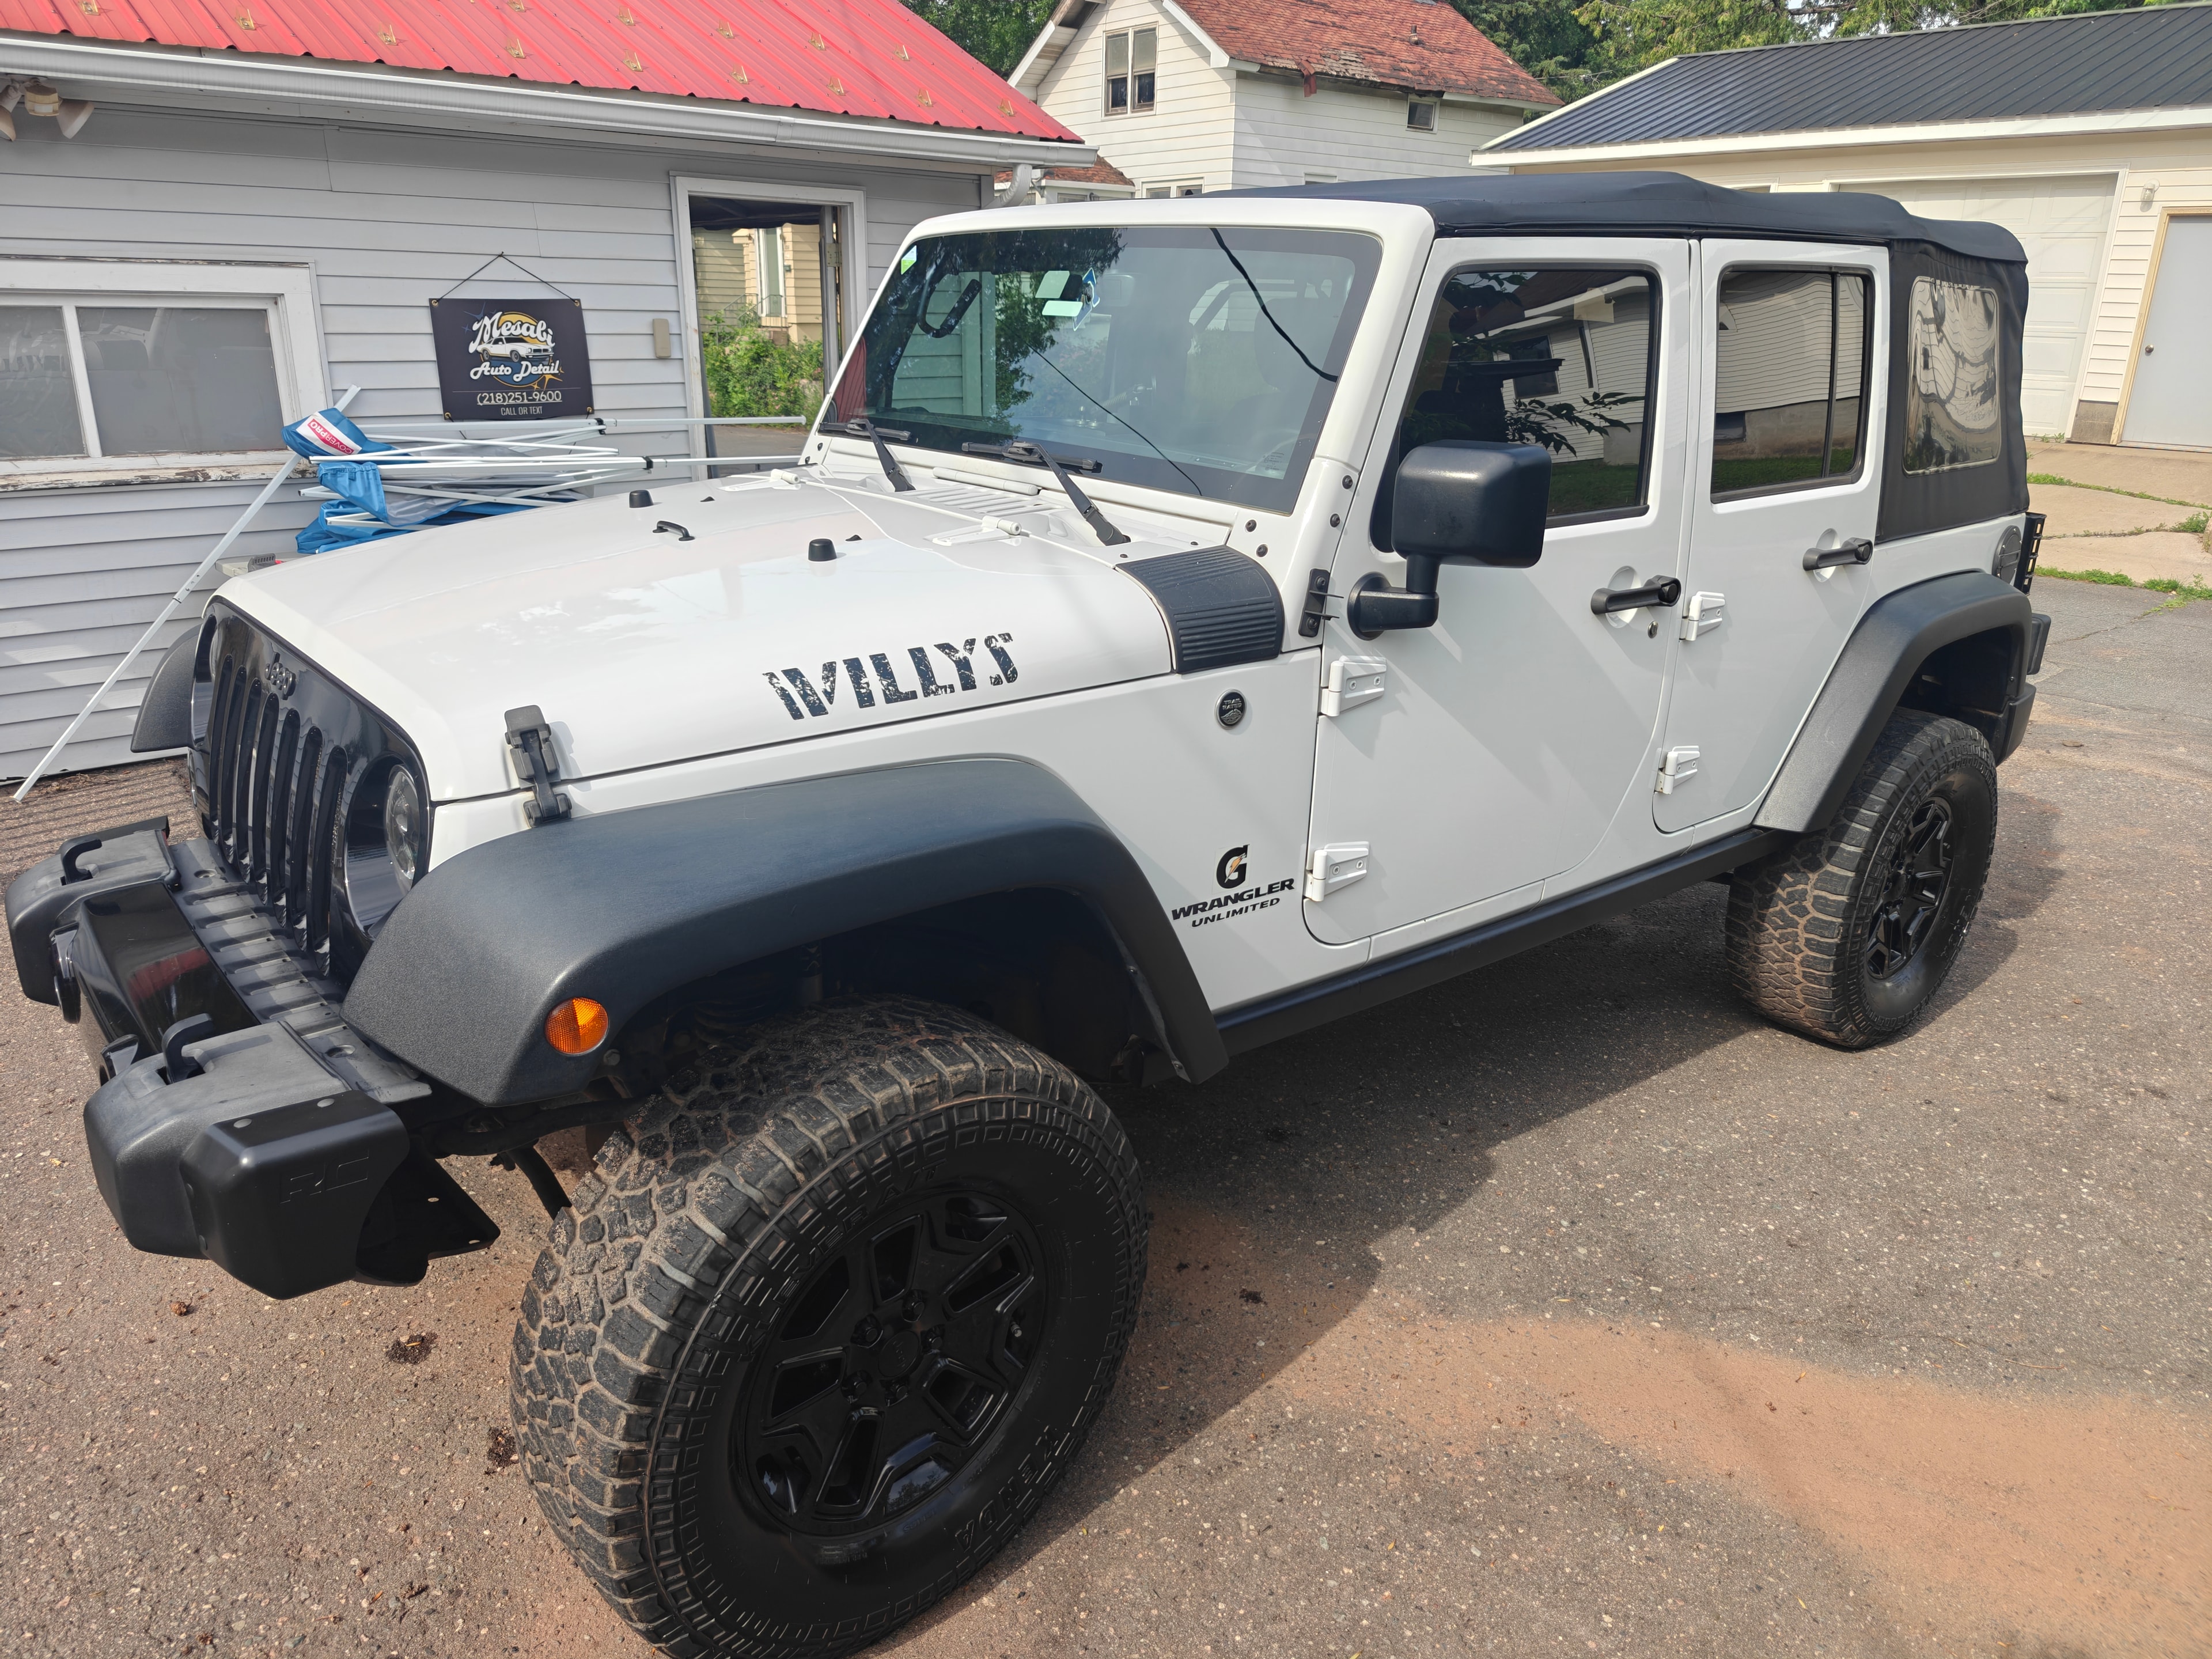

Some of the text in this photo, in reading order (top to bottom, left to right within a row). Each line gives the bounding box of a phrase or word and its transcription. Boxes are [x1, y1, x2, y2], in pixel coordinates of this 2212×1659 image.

[469, 312, 555, 353] Mesabi
[470, 361, 559, 382] Auto Detail
[477, 391, 562, 405] (218)251-9600
[501, 406, 543, 415] CALL OR TEXT
[309, 421, 353, 454] COVERPRO
[762, 632, 1018, 720] WILLYS
[1172, 878, 1294, 920] WRANGLER
[1192, 897, 1280, 927] UNLIMITED
[955, 1425, 1058, 1552] KENDA
